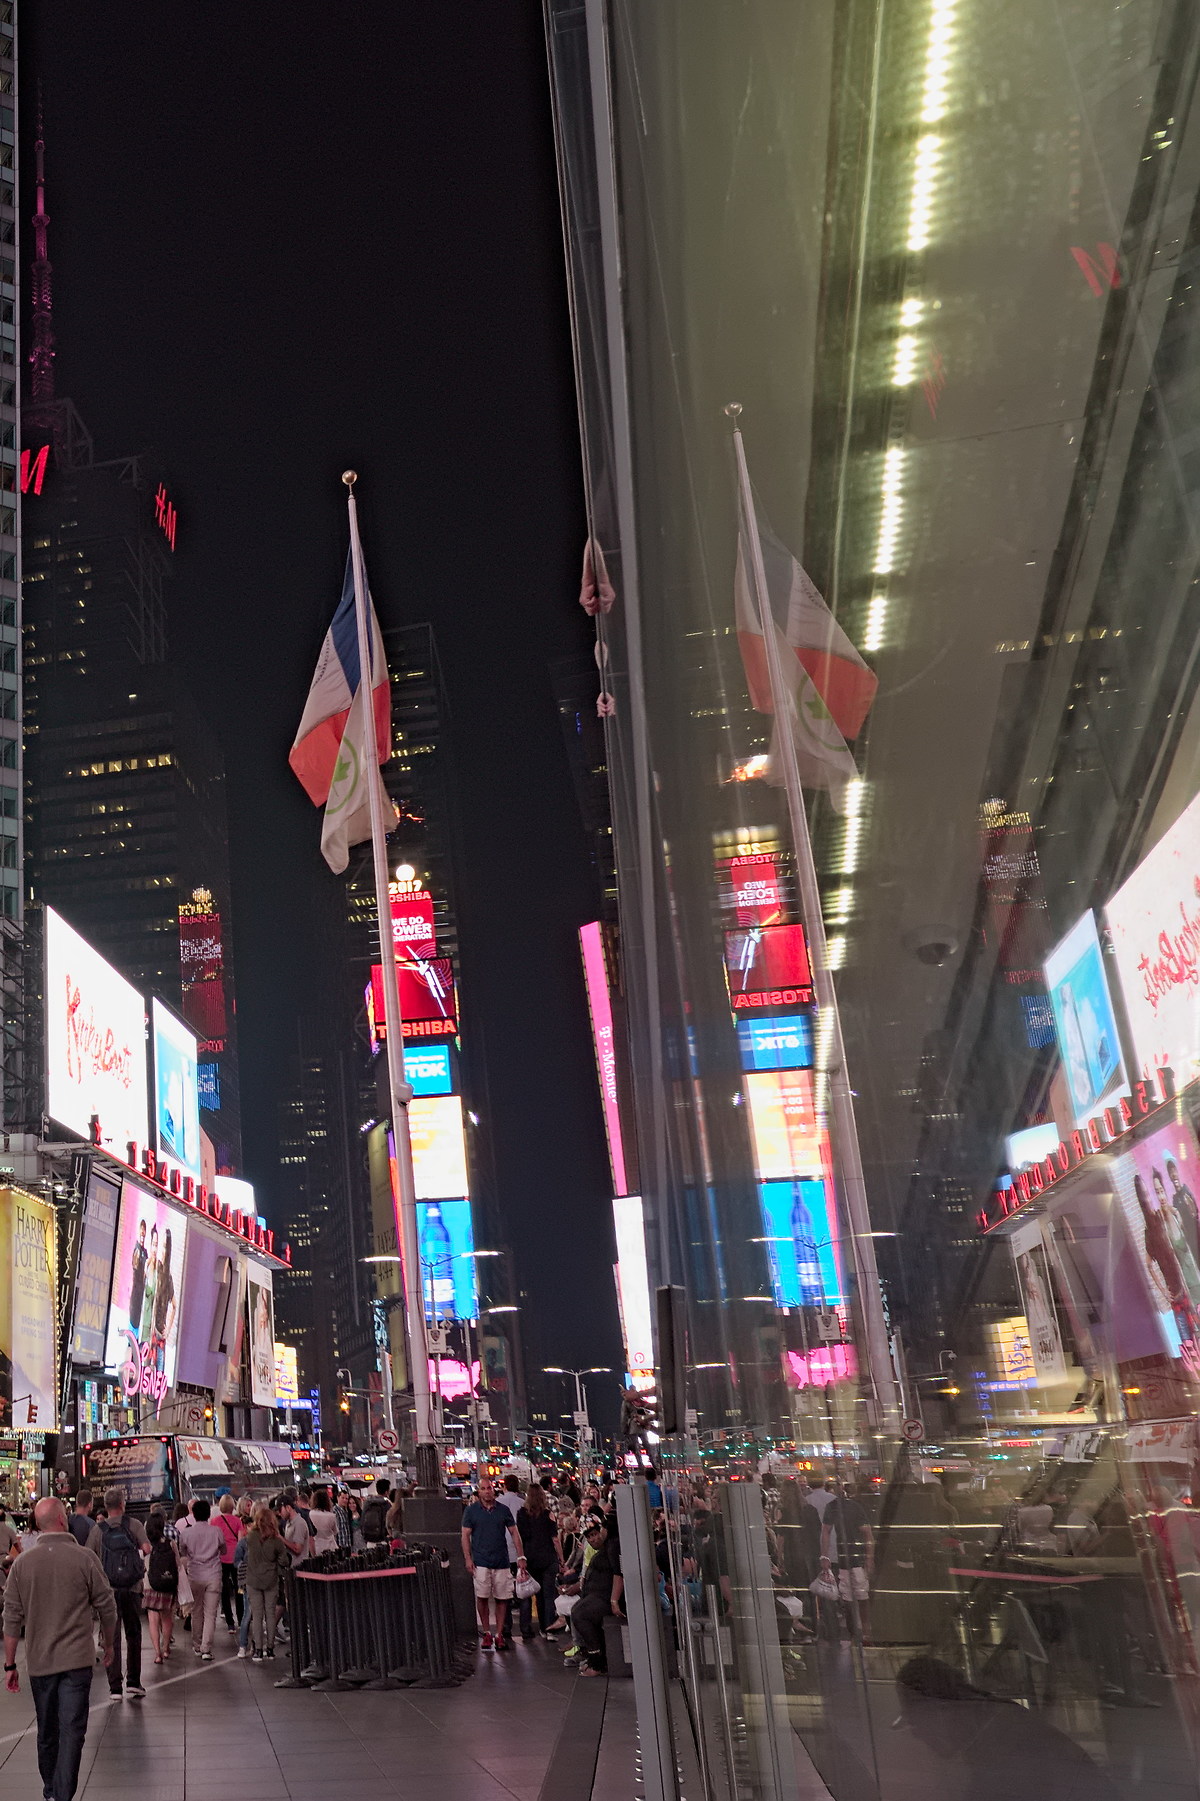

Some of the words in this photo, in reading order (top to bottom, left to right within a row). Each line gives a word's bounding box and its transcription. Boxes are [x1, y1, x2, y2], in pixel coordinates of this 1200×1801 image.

[388, 881, 422, 894] 2017
[390, 891, 431, 902] OSHIBA
[392, 917, 407, 926] WE
[409, 916, 424, 925] DO
[393, 923, 432, 934] OWER
[376, 1019, 456, 1038] TSHIBA
[127, 1141, 181, 1193] 1540
[184, 1176, 274, 1253] BROADWAY
[16, 1206, 51, 1249] HARRY
[14, 1235, 53, 1276] POTTER
